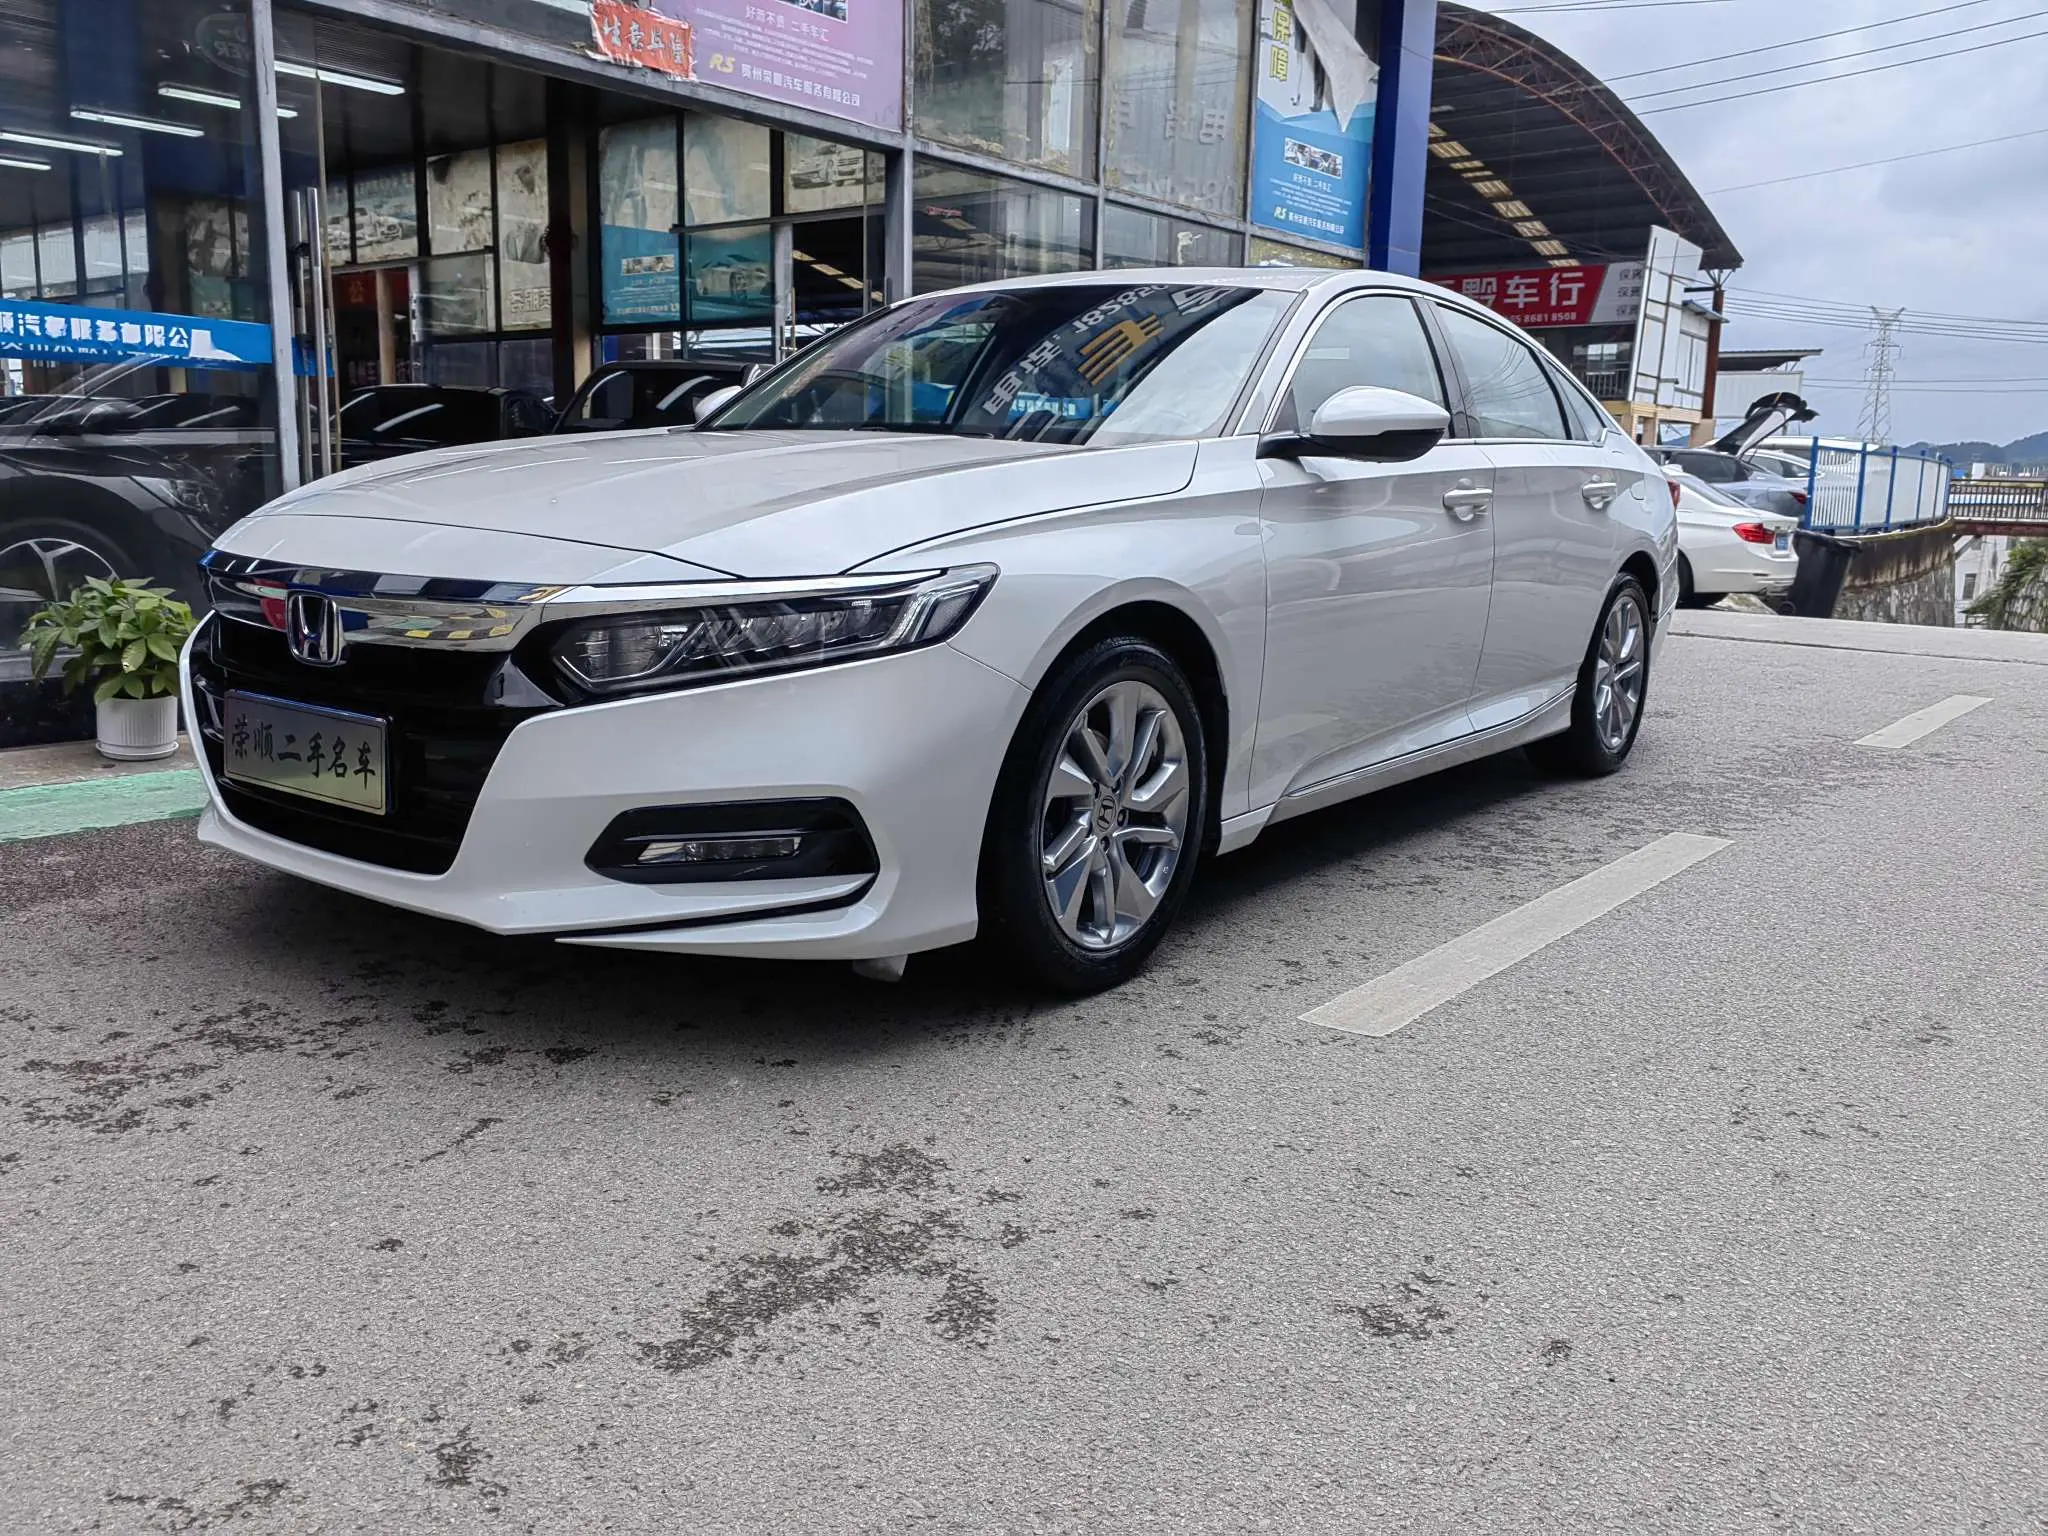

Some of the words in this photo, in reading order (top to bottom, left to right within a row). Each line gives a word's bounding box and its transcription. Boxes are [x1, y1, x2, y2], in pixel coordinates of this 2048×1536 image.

[709, 53, 736, 73] RS
[1271, 0, 1292, 81] 保障
[1436, 272, 1585, 309] 黔车行
[232, 714, 376, 790] 荣顺二手名车
